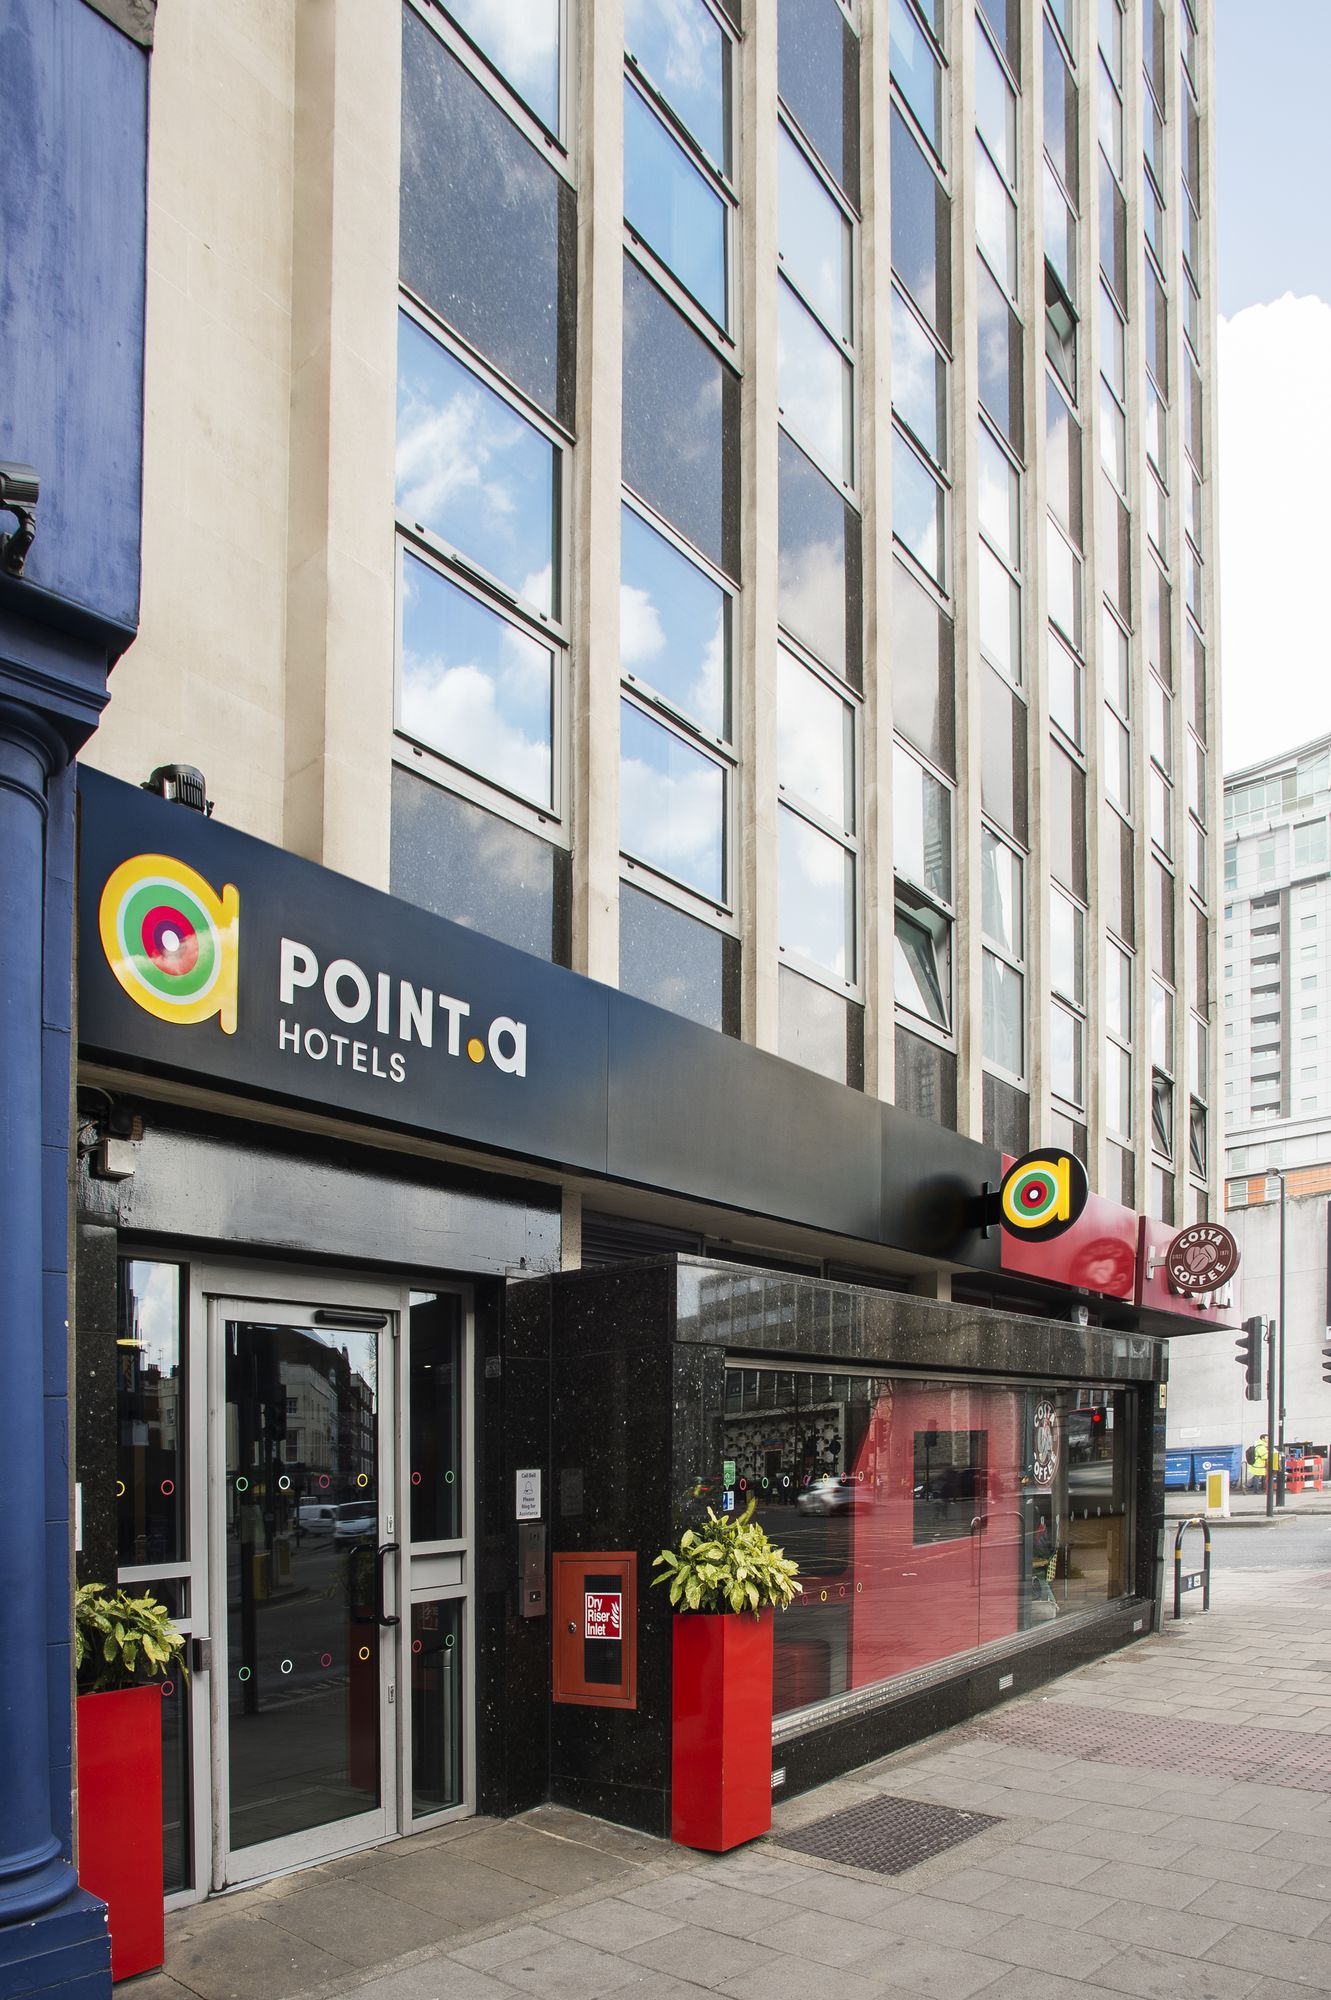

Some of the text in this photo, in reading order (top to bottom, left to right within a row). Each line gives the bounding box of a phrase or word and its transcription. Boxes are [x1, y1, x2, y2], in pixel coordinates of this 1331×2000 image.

[279, 1018, 406, 1083] HOTELS
[1180, 1229, 1224, 1248] COSTA
[1174, 1262, 1226, 1285] COFFEE
[588, 1596, 602, 1611] Dry
[588, 1609, 610, 1622] Riser
[588, 1623, 606, 1635] Inlet
